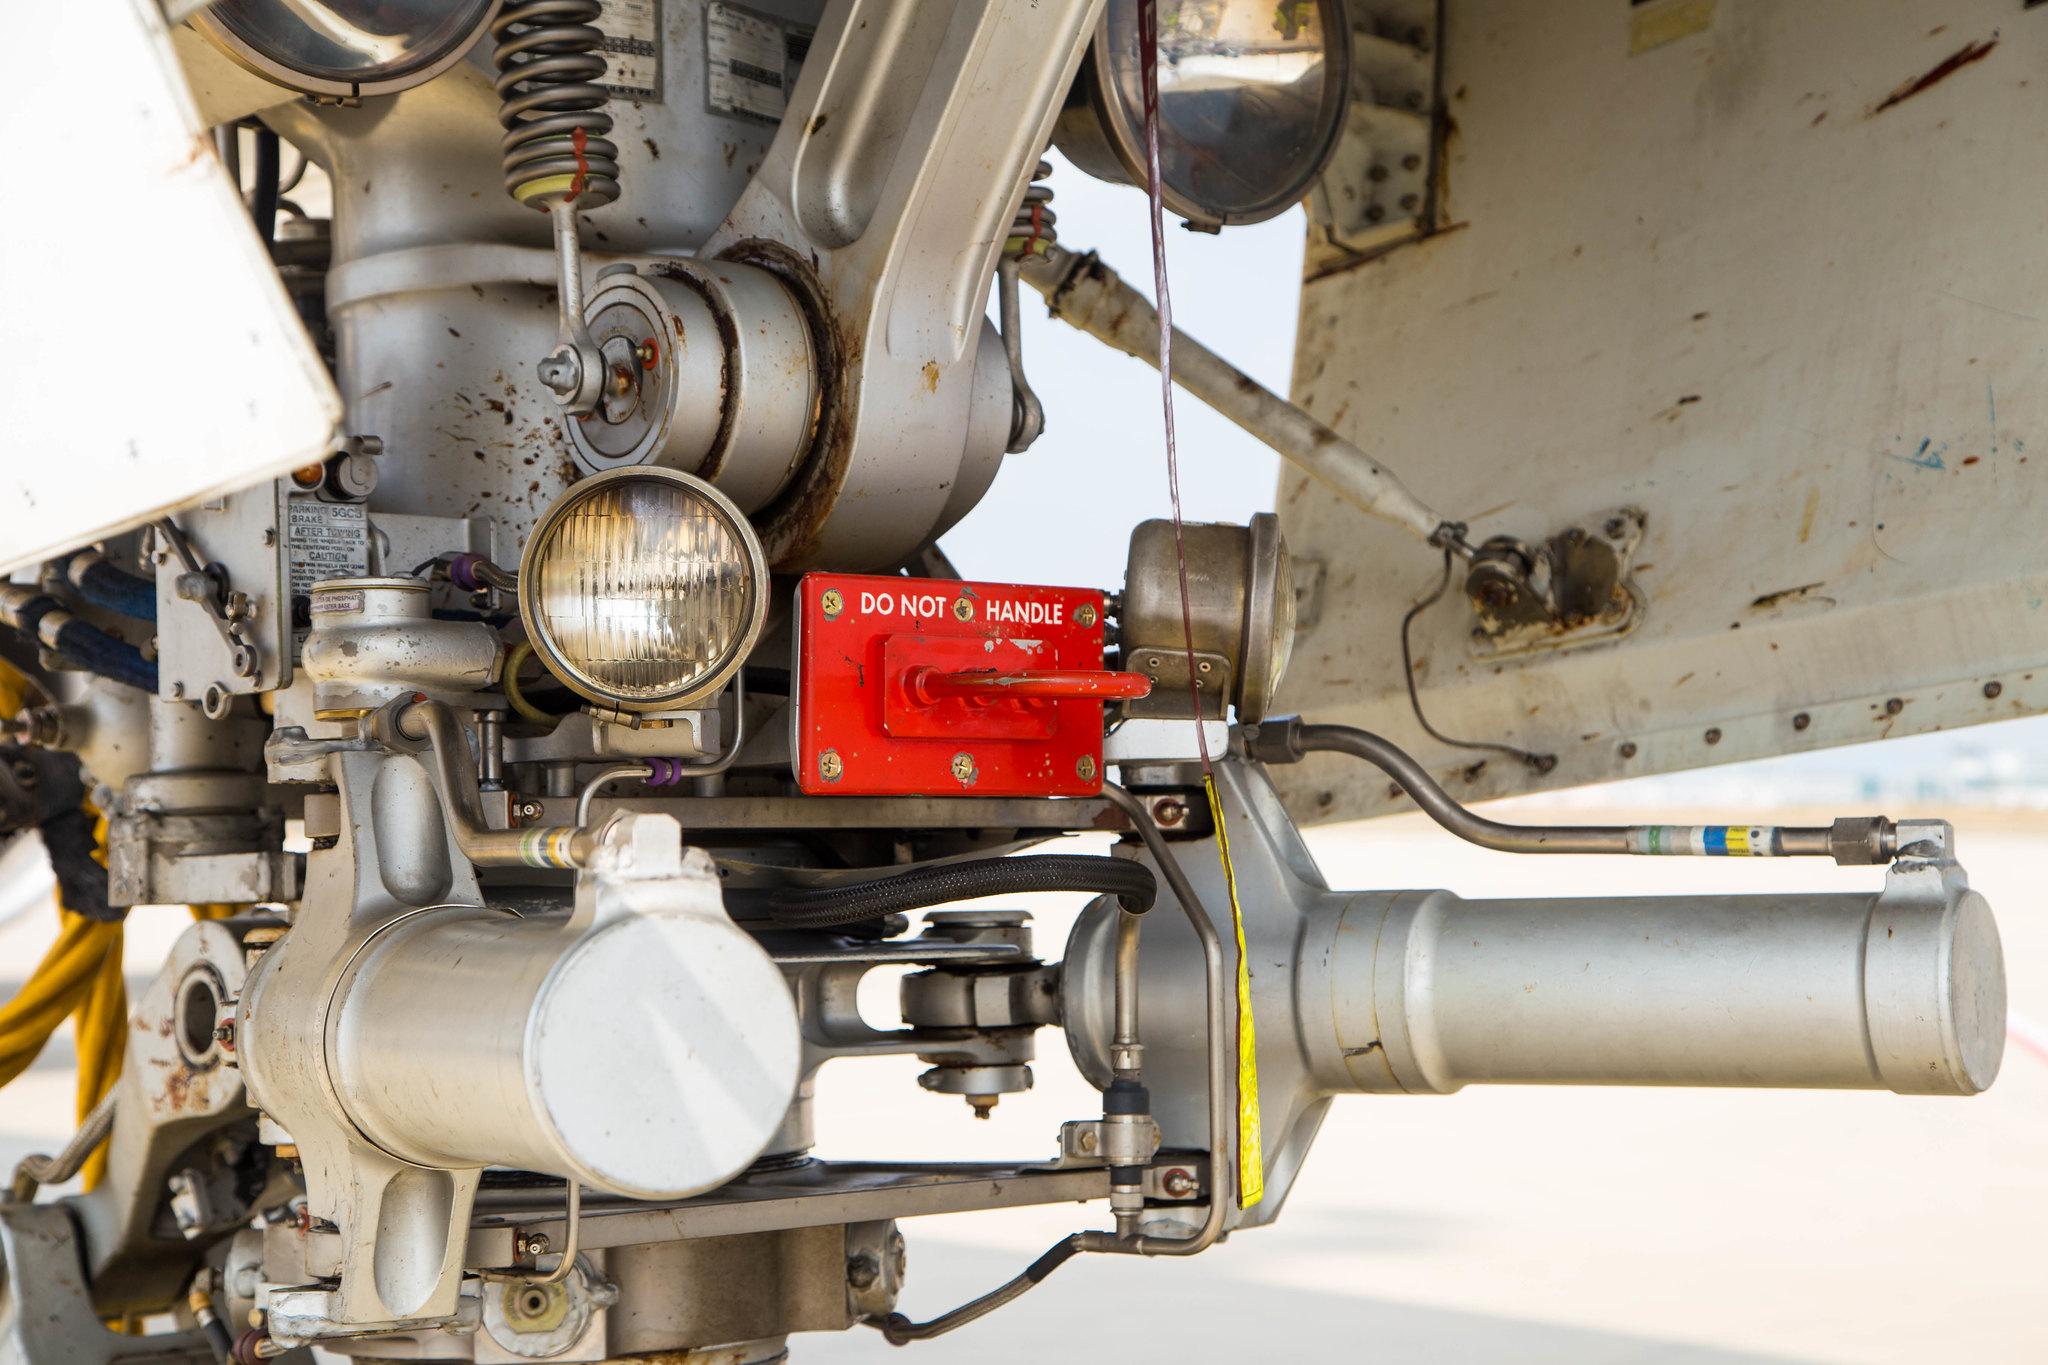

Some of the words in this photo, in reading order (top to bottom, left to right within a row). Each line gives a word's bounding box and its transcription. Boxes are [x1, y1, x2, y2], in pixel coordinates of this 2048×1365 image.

[292, 515, 323, 524] BRAKE
[295, 527, 323, 537] AFTER
[309, 551, 348, 561] CAUTION
[861, 592, 894, 615] DO
[901, 594, 946, 618] NOT
[986, 600, 1063, 625] HANDLE
